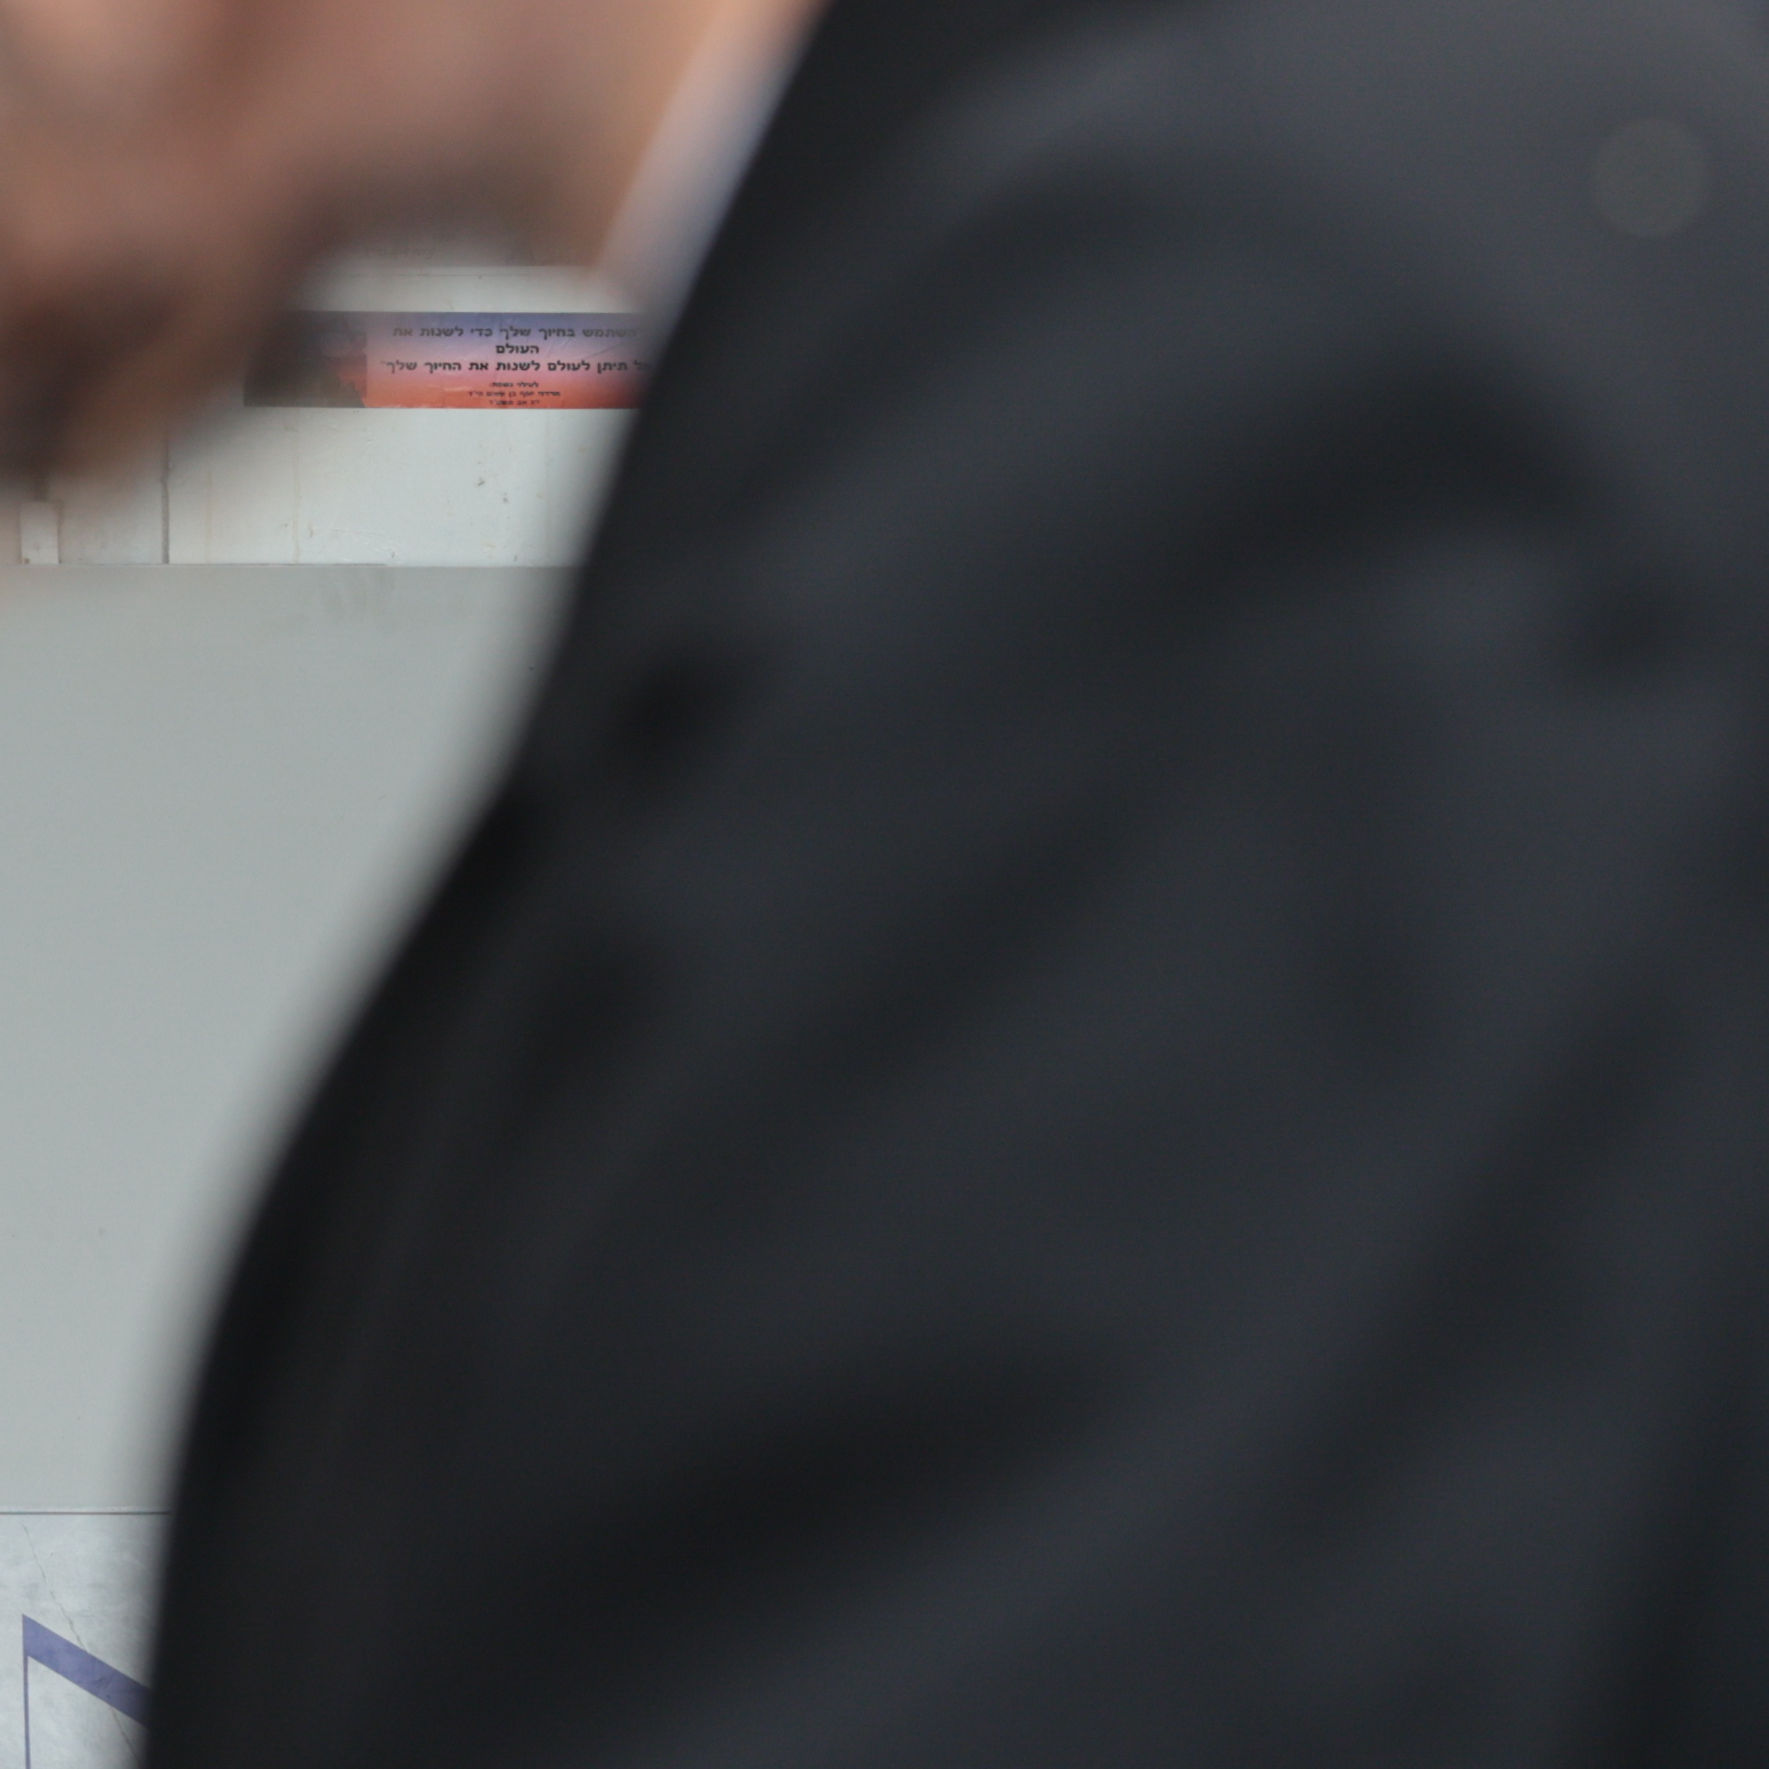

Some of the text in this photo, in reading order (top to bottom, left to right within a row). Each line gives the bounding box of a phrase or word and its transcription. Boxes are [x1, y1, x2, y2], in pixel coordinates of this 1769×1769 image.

[392, 328, 413, 337] את
[419, 326, 464, 337] לשנות
[470, 327, 493, 337] כדי
[500, 326, 532, 340] שלך
[538, 328, 576, 340] בחיוך
[495, 343, 540, 354] העולם
[424, 362, 462, 374] החיוך
[468, 362, 489, 371] את
[495, 360, 541, 371] לשנות
[547, 360, 590, 371] לעולם
[596, 362, 628, 374] תיתן
